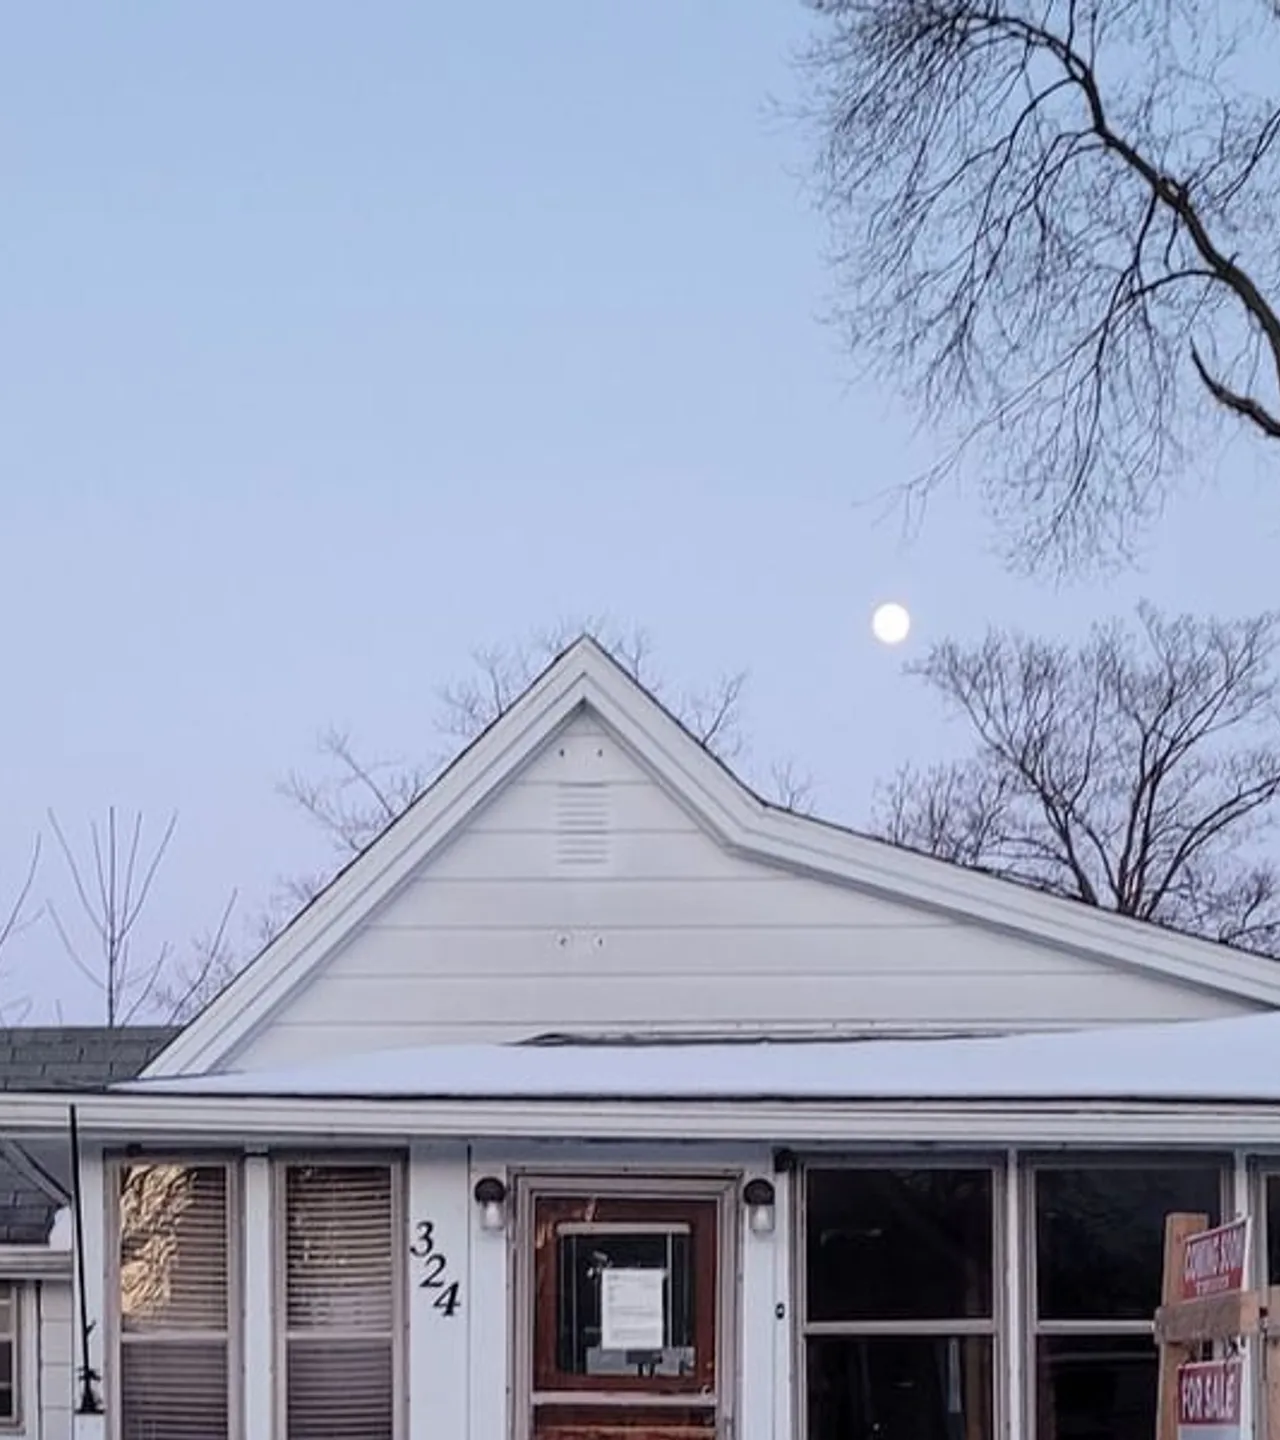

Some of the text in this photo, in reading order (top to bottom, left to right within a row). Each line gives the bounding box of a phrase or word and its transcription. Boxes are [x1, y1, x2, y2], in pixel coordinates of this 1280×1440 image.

[409, 1220, 461, 1317] 324
[1181, 1370, 1237, 1420] FOR SALE
